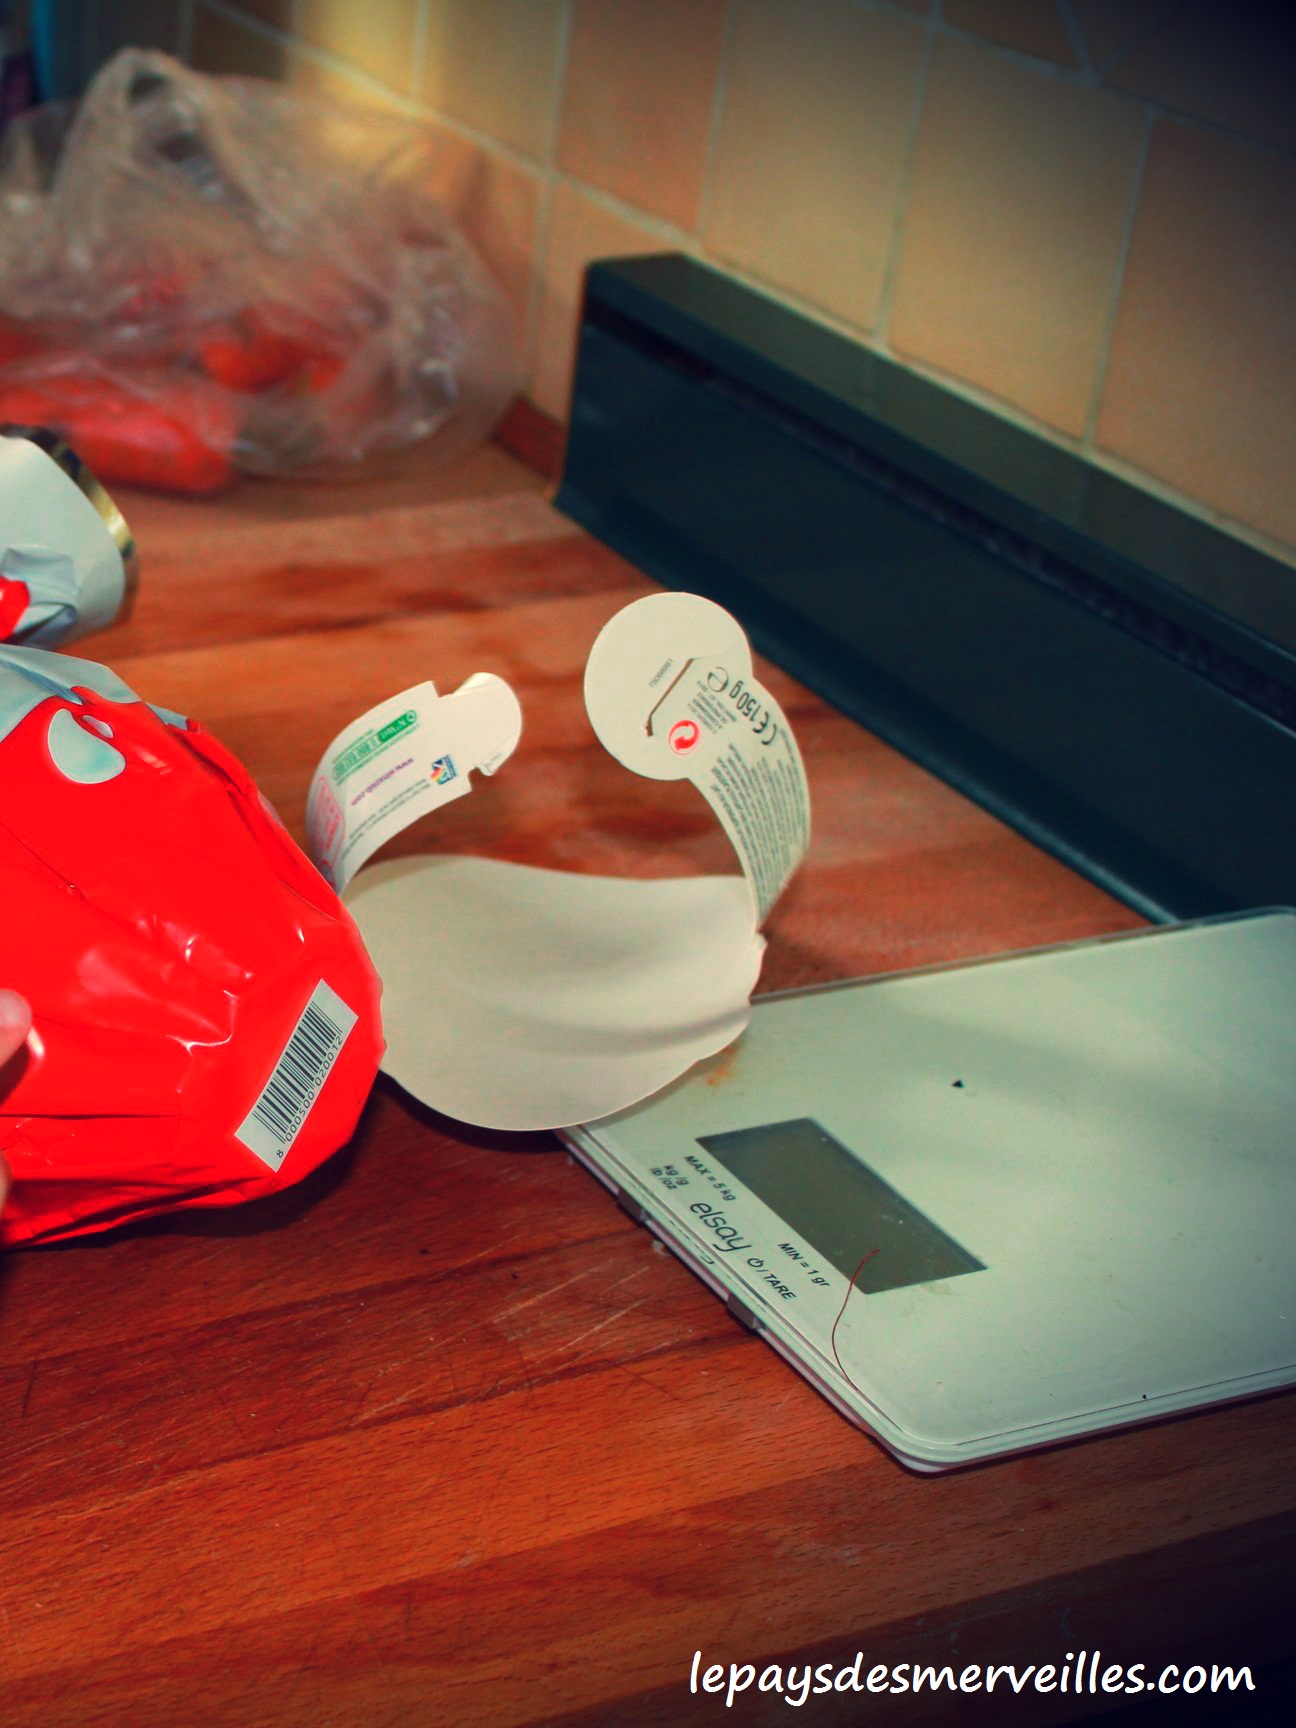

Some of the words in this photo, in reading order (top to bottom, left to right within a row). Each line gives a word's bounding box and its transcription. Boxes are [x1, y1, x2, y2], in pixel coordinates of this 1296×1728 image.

[736, 692, 761, 722] 150
[276, 1149, 284, 1159] 8
[683, 1155, 711, 1176] MAX
[720, 1189, 737, 1202] kg
[689, 1202, 753, 1253] elsay
[763, 1273, 798, 1301] TARE
[777, 1242, 803, 1261] MIN
[811, 1276, 832, 1288] gr
